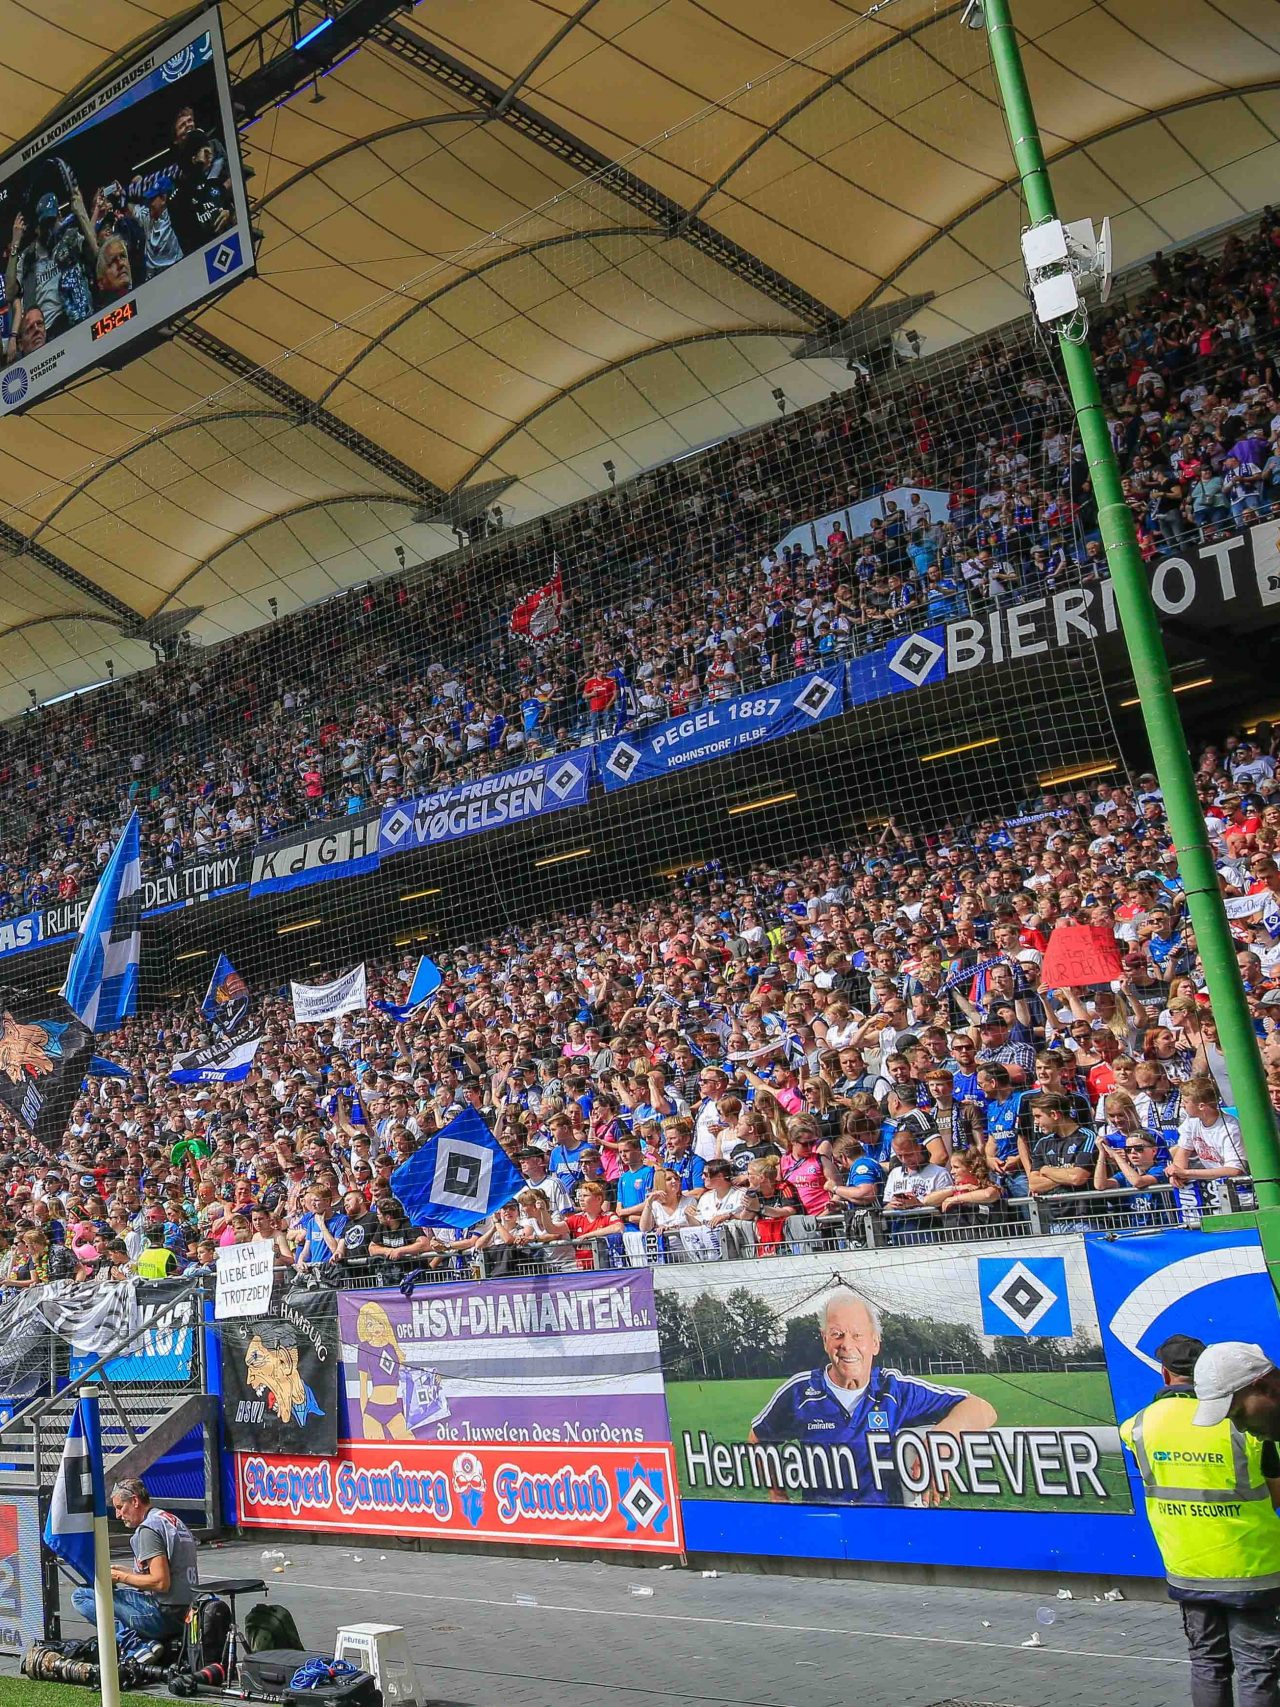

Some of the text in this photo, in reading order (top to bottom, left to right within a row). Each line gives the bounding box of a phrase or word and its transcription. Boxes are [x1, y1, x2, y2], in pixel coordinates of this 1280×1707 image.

[22, 57, 156, 162] WILLKOMMEN ZUHAUSE!
[93, 303, 132, 339] 15:24
[29, 349, 66, 375] VOLKSPARK
[30, 362, 58, 382] STADION
[651, 697, 782, 755] PEGEL 1887
[667, 736, 730, 768] HOHNSTORF
[738, 727, 768, 744] ELBE
[417, 764, 545, 814] HSV-FREUNDE
[414, 783, 546, 842] VØGELSEN
[47, 901, 87, 936] RUHE
[180, 856, 240, 896] TOMMY
[220, 1261, 269, 1285] LIEBE EUCH
[236, 1247, 256, 1263] ICH
[220, 1284, 270, 1307] TROTZDEM
[397, 1286, 651, 1341] OFC HSV-DIAMANTEN e.V.
[280, 1302, 329, 1363] HAMBURG
[436, 1419, 645, 1444] die Juwelen des Nordens
[807, 1422, 836, 1431] Emirates
[680, 1426, 1111, 1500] Hermann FOREVER
[1173, 1451, 1225, 1464] POWER
[246, 1456, 613, 1526] Respect Hamburg Fanclub
[1158, 1503, 1242, 1518] EVENT SECURITY
[343, 1635, 369, 1646] REUTERS
